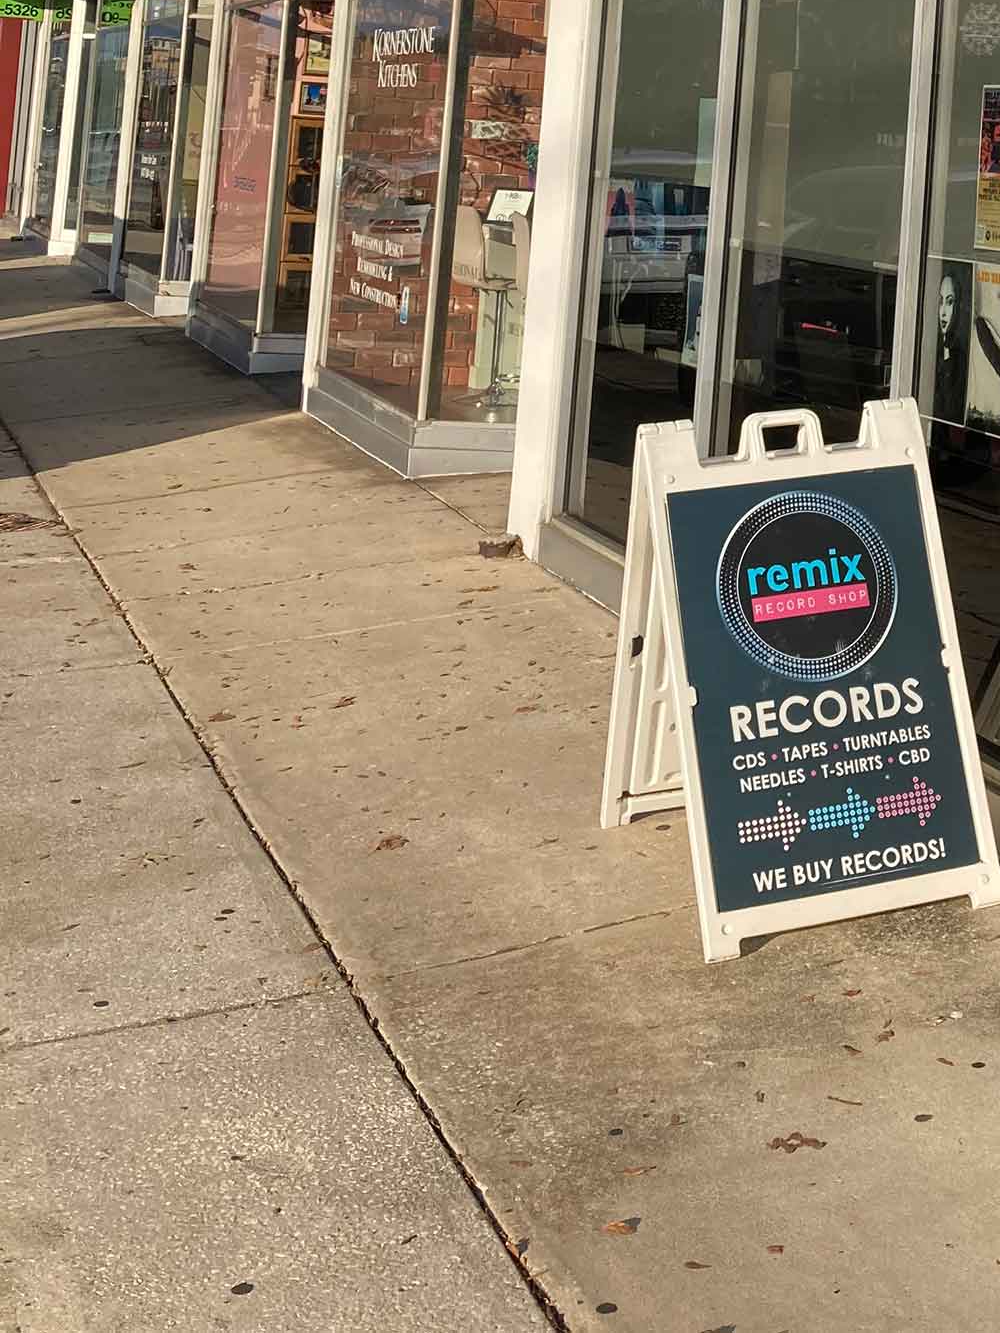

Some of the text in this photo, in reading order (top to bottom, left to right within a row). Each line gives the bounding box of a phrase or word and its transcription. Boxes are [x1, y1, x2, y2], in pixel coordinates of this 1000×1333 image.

[373, 26, 435, 62] KORNERSTONE
[378, 60, 417, 87] KITCHENS
[748, 548, 865, 595] remix
[754, 588, 867, 617] RECORD SHOP
[729, 677, 925, 743] RECORDS
[733, 724, 931, 770] CDS TAPES TURNTABLES
[739, 747, 930, 793] NEEDLES T-SHIRTS CBD
[753, 838, 947, 893] WE BUY RECORDS!
